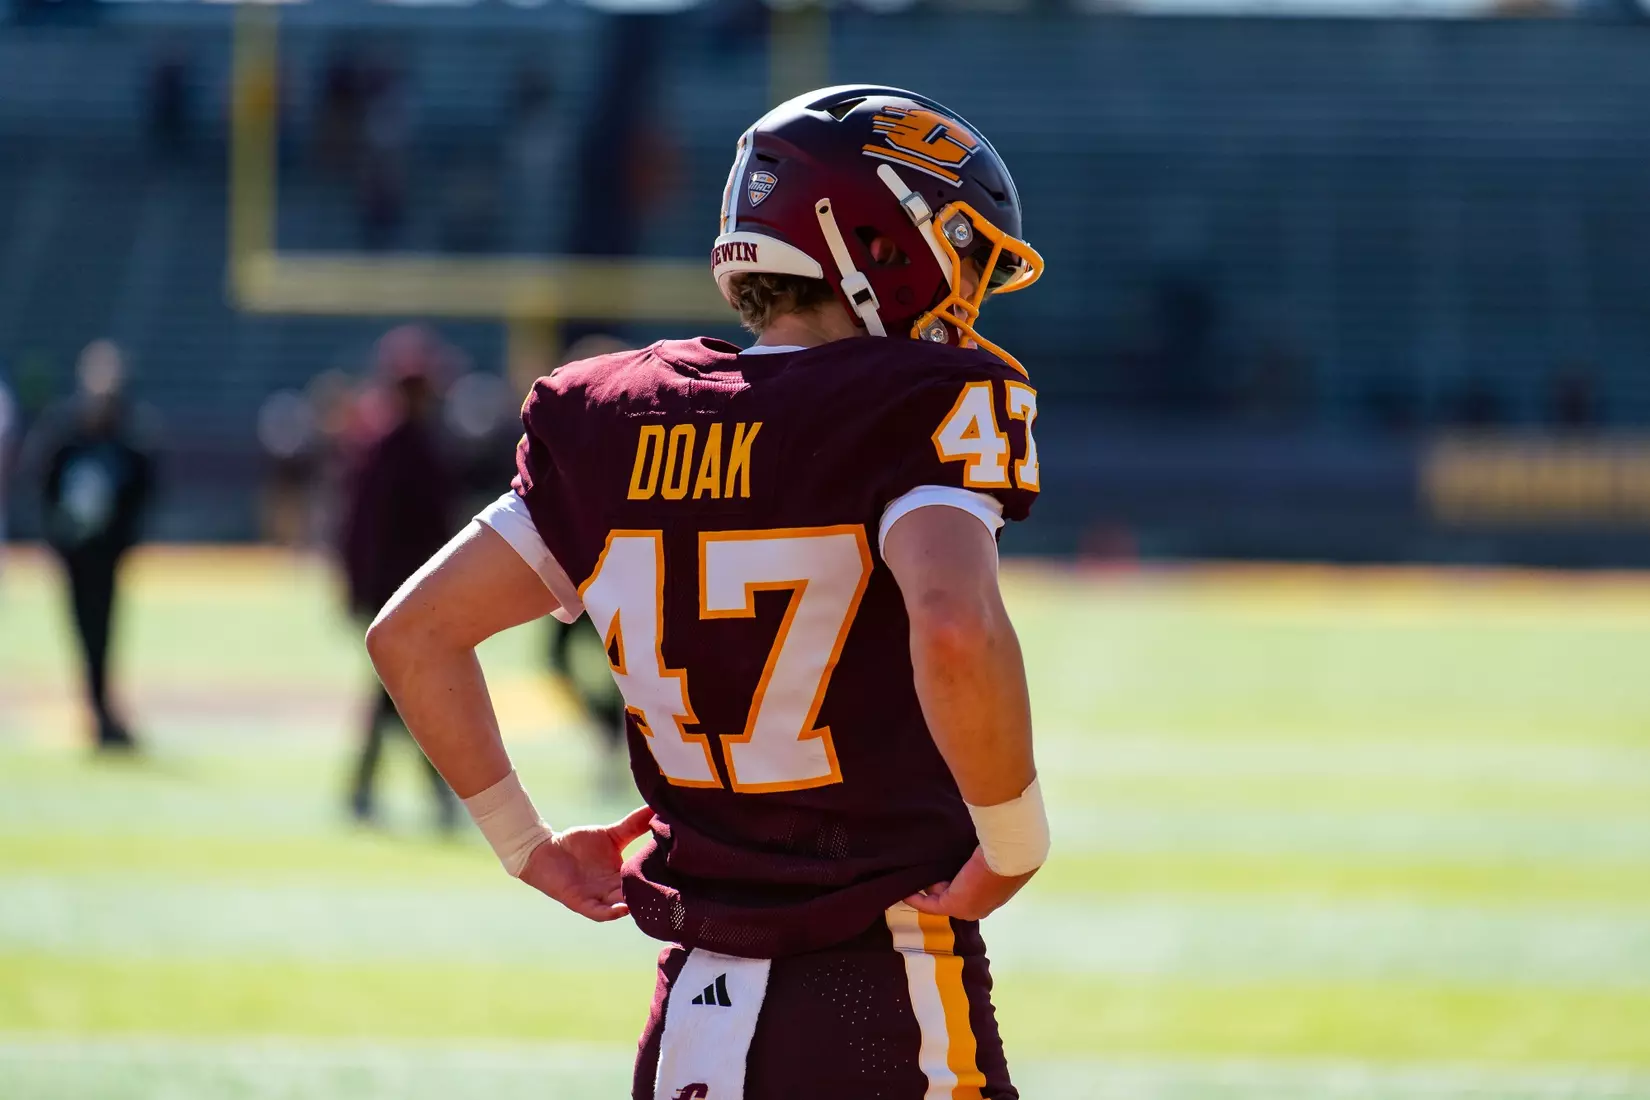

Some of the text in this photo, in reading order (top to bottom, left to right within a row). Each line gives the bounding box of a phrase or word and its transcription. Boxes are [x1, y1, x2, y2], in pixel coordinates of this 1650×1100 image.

[627, 421, 763, 500] DOAK
[930, 379, 1040, 492] 47
[578, 523, 874, 793] 47
